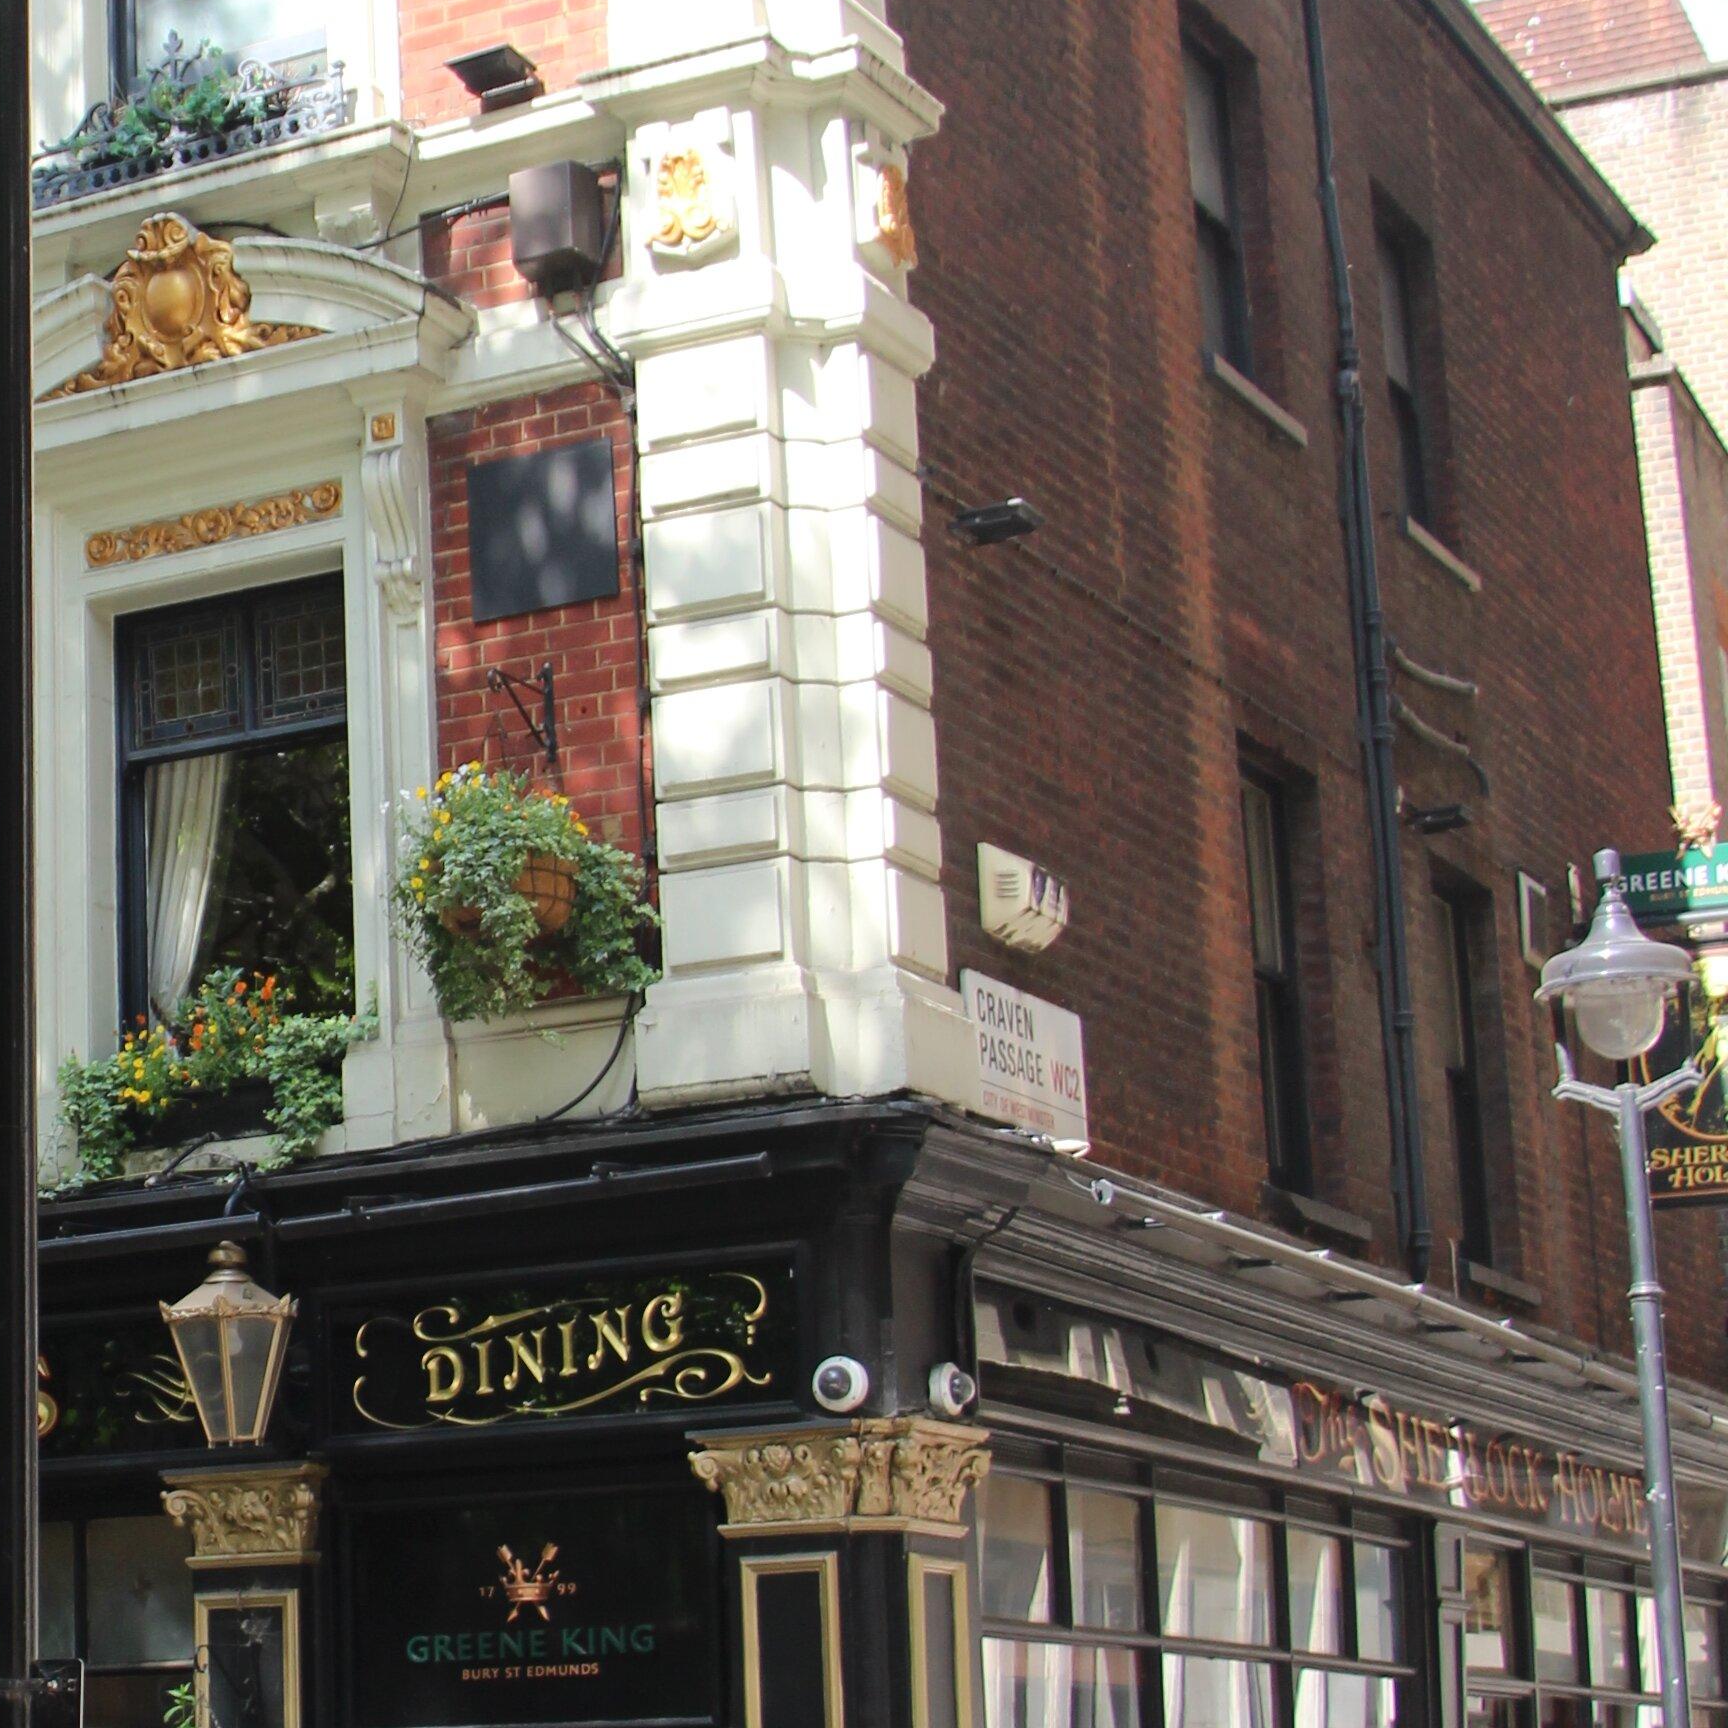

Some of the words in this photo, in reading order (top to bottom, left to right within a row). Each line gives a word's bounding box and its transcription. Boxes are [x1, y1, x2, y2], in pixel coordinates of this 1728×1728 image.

[1617, 864, 1708, 893] GREENE
[976, 987, 1034, 1042] CRAVEN
[979, 1032, 1044, 1088] PASSAGE
[1049, 1058, 1082, 1103] WC2
[1649, 1144, 1728, 1170] SHER
[421, 1291, 685, 1403] DINING
[1552, 1451, 1649, 1535] HOLME
[479, 1586, 495, 1598] 17
[556, 1583, 578, 1595] 99
[406, 1629, 548, 1663] GREENE
[562, 1624, 656, 1656] KING
[461, 1668, 499, 1681] BURY
[504, 1666, 521, 1678] ST
[526, 1662, 600, 1678] EDMUNDS
